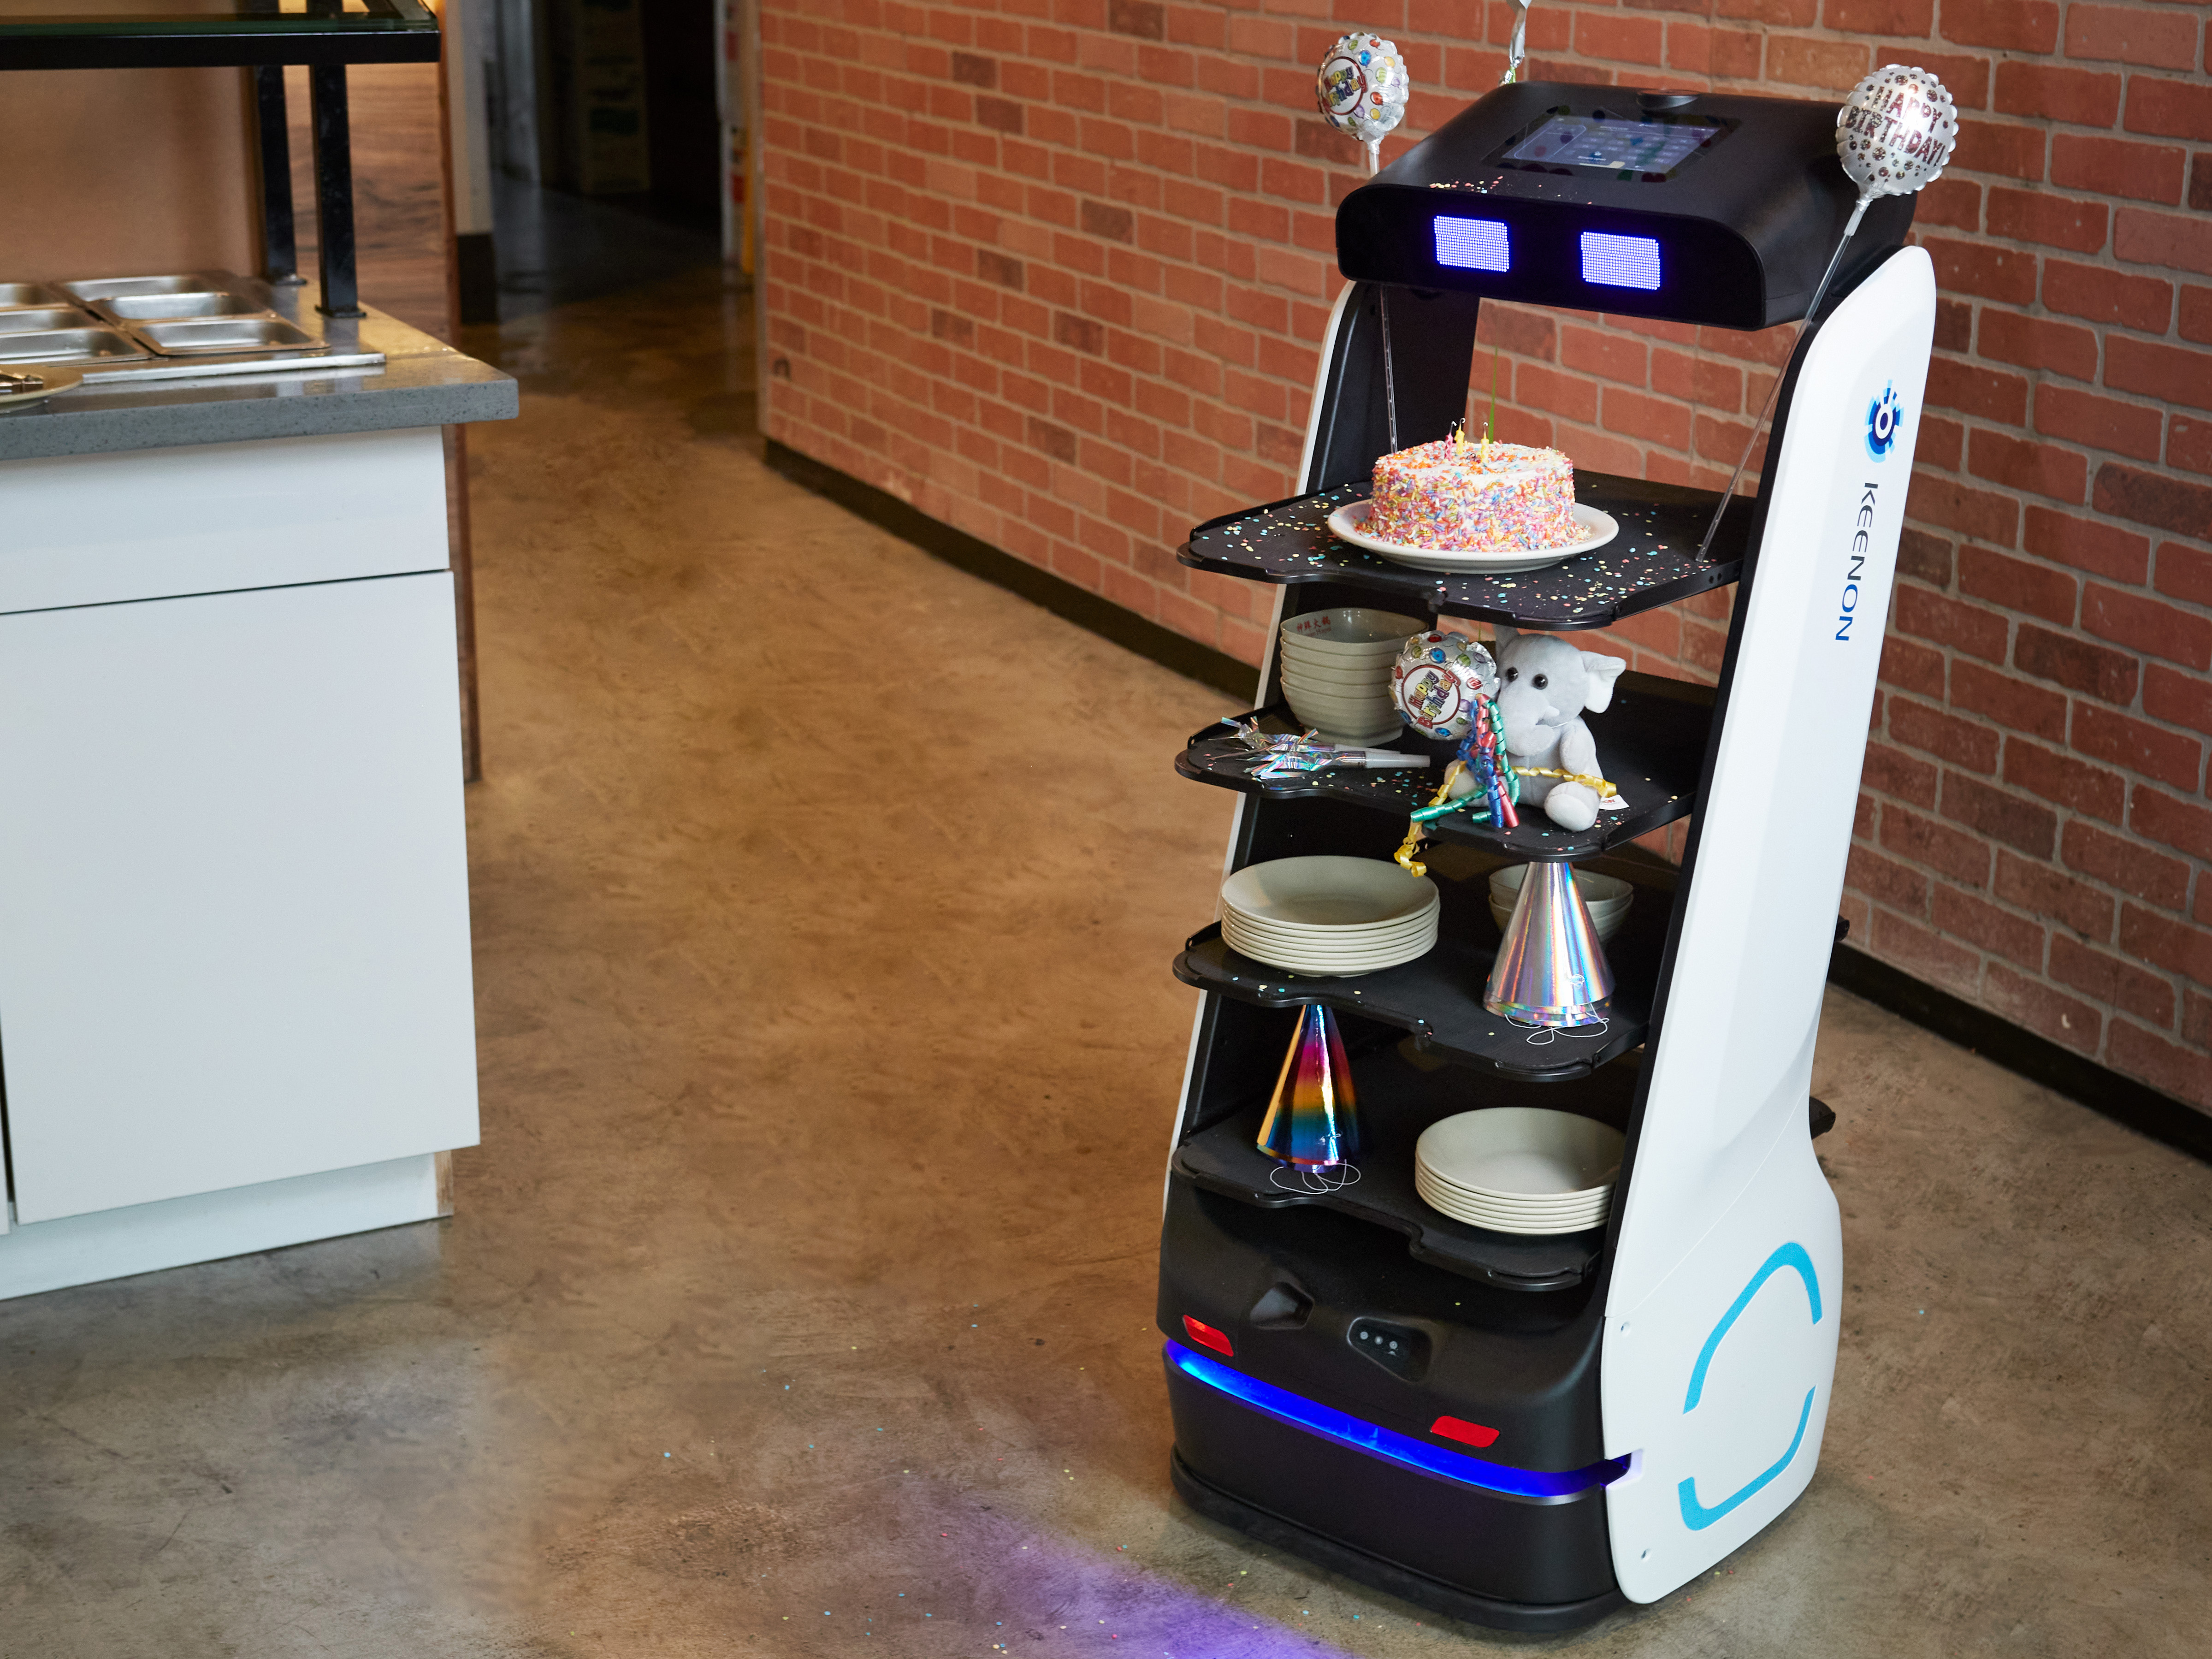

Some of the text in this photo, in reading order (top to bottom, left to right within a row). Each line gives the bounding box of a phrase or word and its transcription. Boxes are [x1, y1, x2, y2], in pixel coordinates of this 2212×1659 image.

[1324, 65, 1354, 92] Happy
[1872, 86, 1942, 133] HAPPY
[1845, 106, 1946, 167] BIRTHDAY!
[1835, 482, 1878, 641] KEENON
[1408, 670, 1439, 709] Happy
[1417, 670, 1461, 729] Birthday
